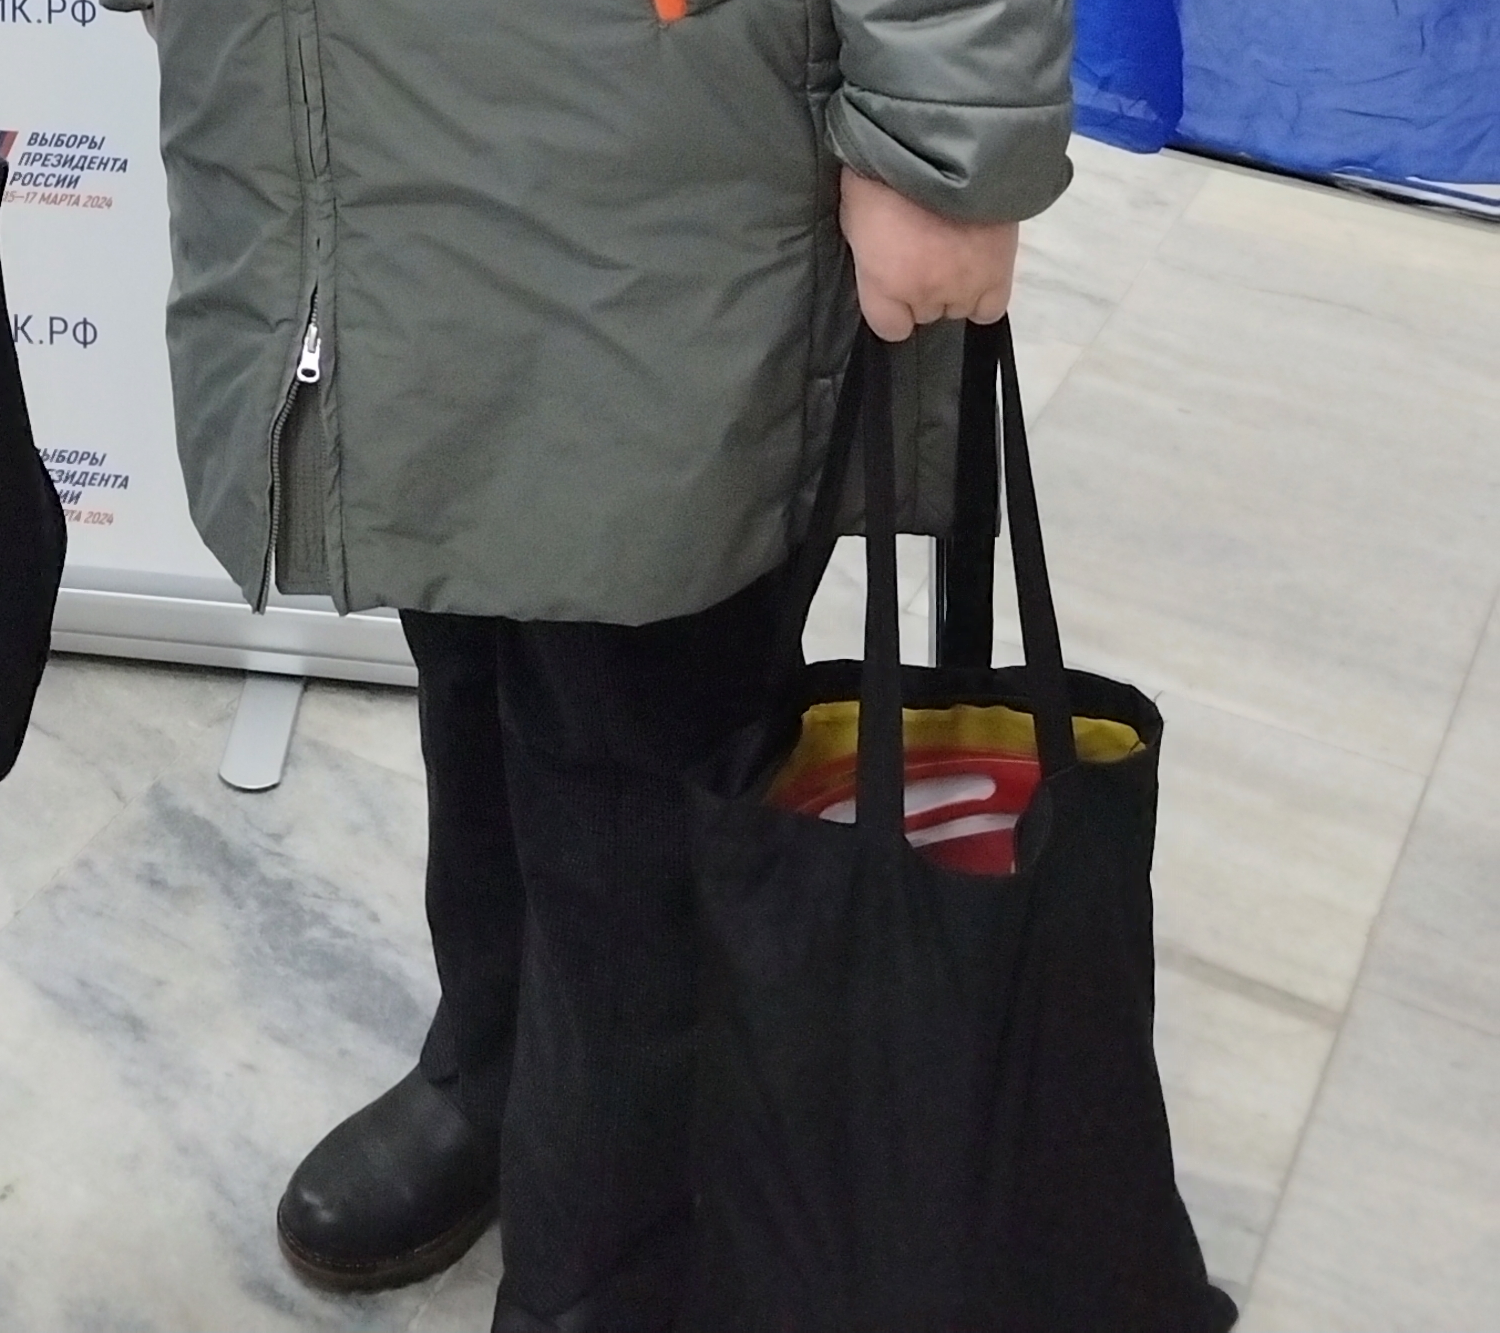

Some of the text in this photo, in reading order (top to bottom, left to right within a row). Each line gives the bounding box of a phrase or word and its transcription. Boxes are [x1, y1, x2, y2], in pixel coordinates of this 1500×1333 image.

[27, 132, 106, 150] ВЫБОРЫ
[18, 151, 128, 173] ПРЕЗИДЕНТА
[9, 172, 81, 189] РОССИИ
[39, 191, 81, 208] МАРТА
[83, 195, 113, 209] 2024
[13, 314, 98, 349] К.РФ
[39, 448, 107, 467] ЫБОРЫ
[83, 510, 114, 525] 2024
